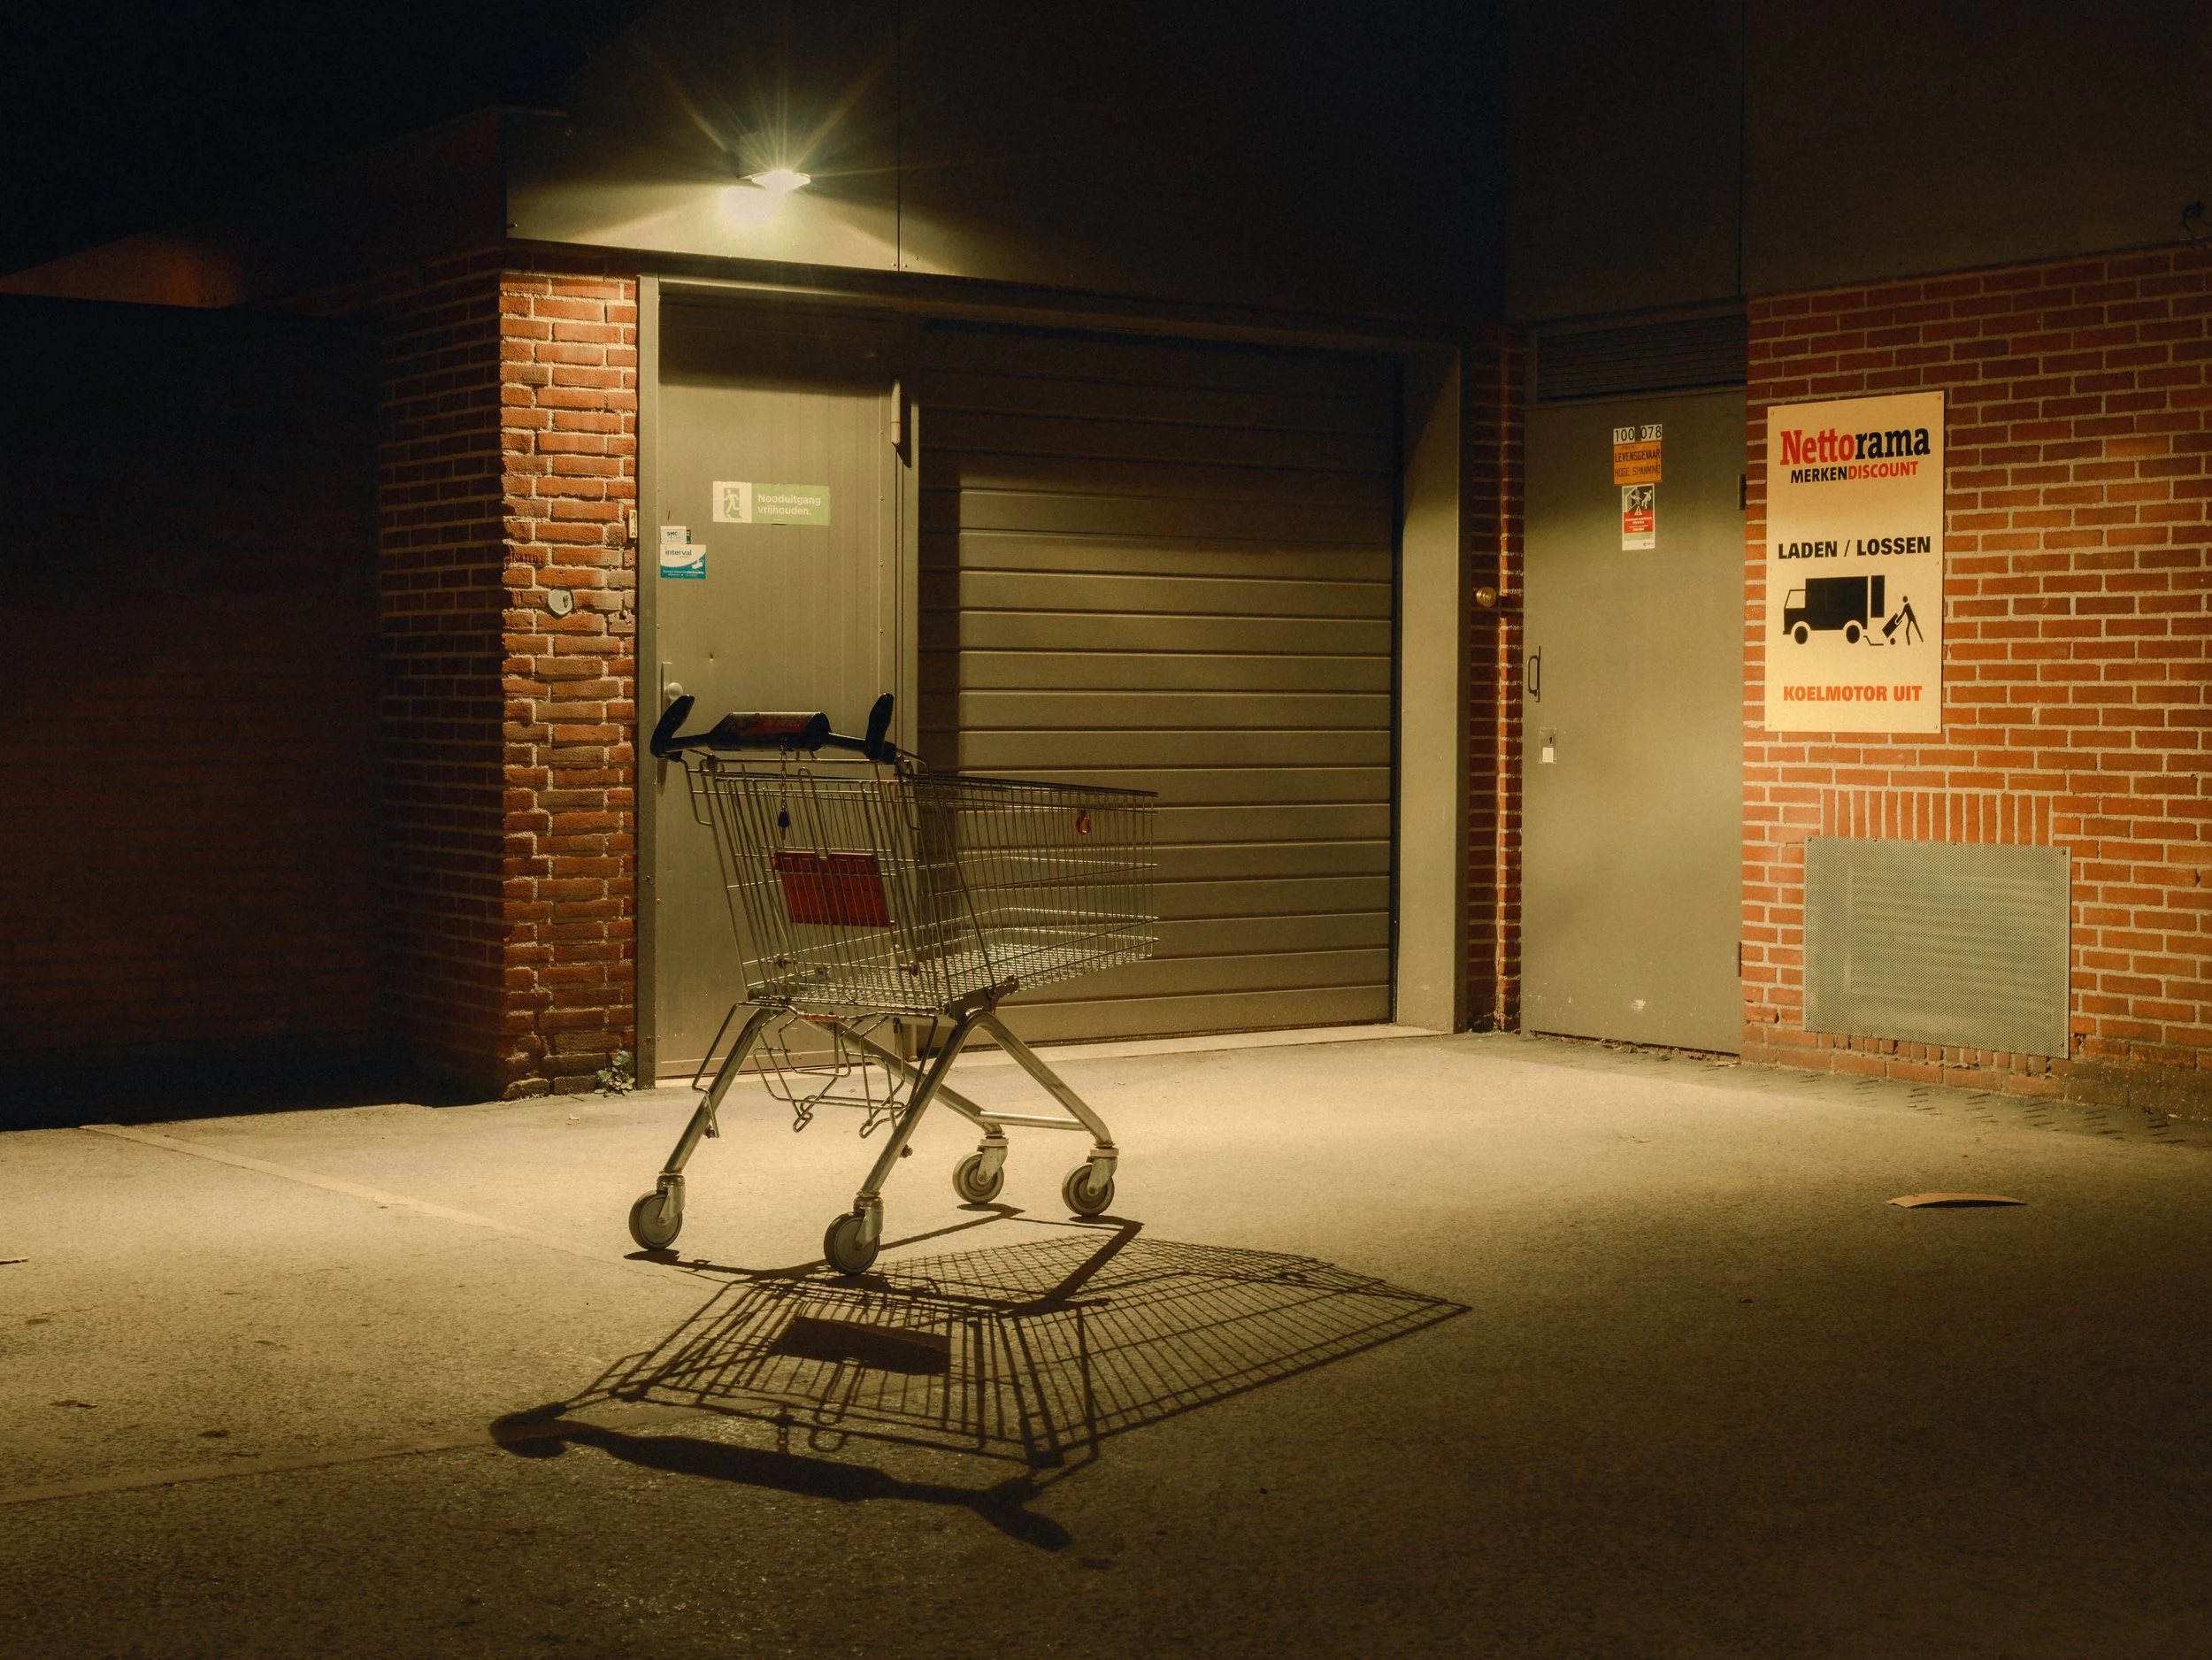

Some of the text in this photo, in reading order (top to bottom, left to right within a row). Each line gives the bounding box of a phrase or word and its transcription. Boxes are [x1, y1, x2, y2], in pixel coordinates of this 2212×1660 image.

[1615, 425, 1662, 442] 100 078
[1779, 426, 1931, 465] Nettorama
[1614, 449, 1661, 463] LEVENSGEVAAR
[1614, 464, 1661, 478] HOGE SPANNING
[1790, 460, 1919, 484] MERKENDISCOUNT
[757, 493, 822, 506] Nooduitgang
[757, 505, 812, 516] vrijhouden.
[1778, 535, 1932, 559] LADEN / LOSSEN
[1783, 685, 1923, 702] KOELMOTOR UIT
